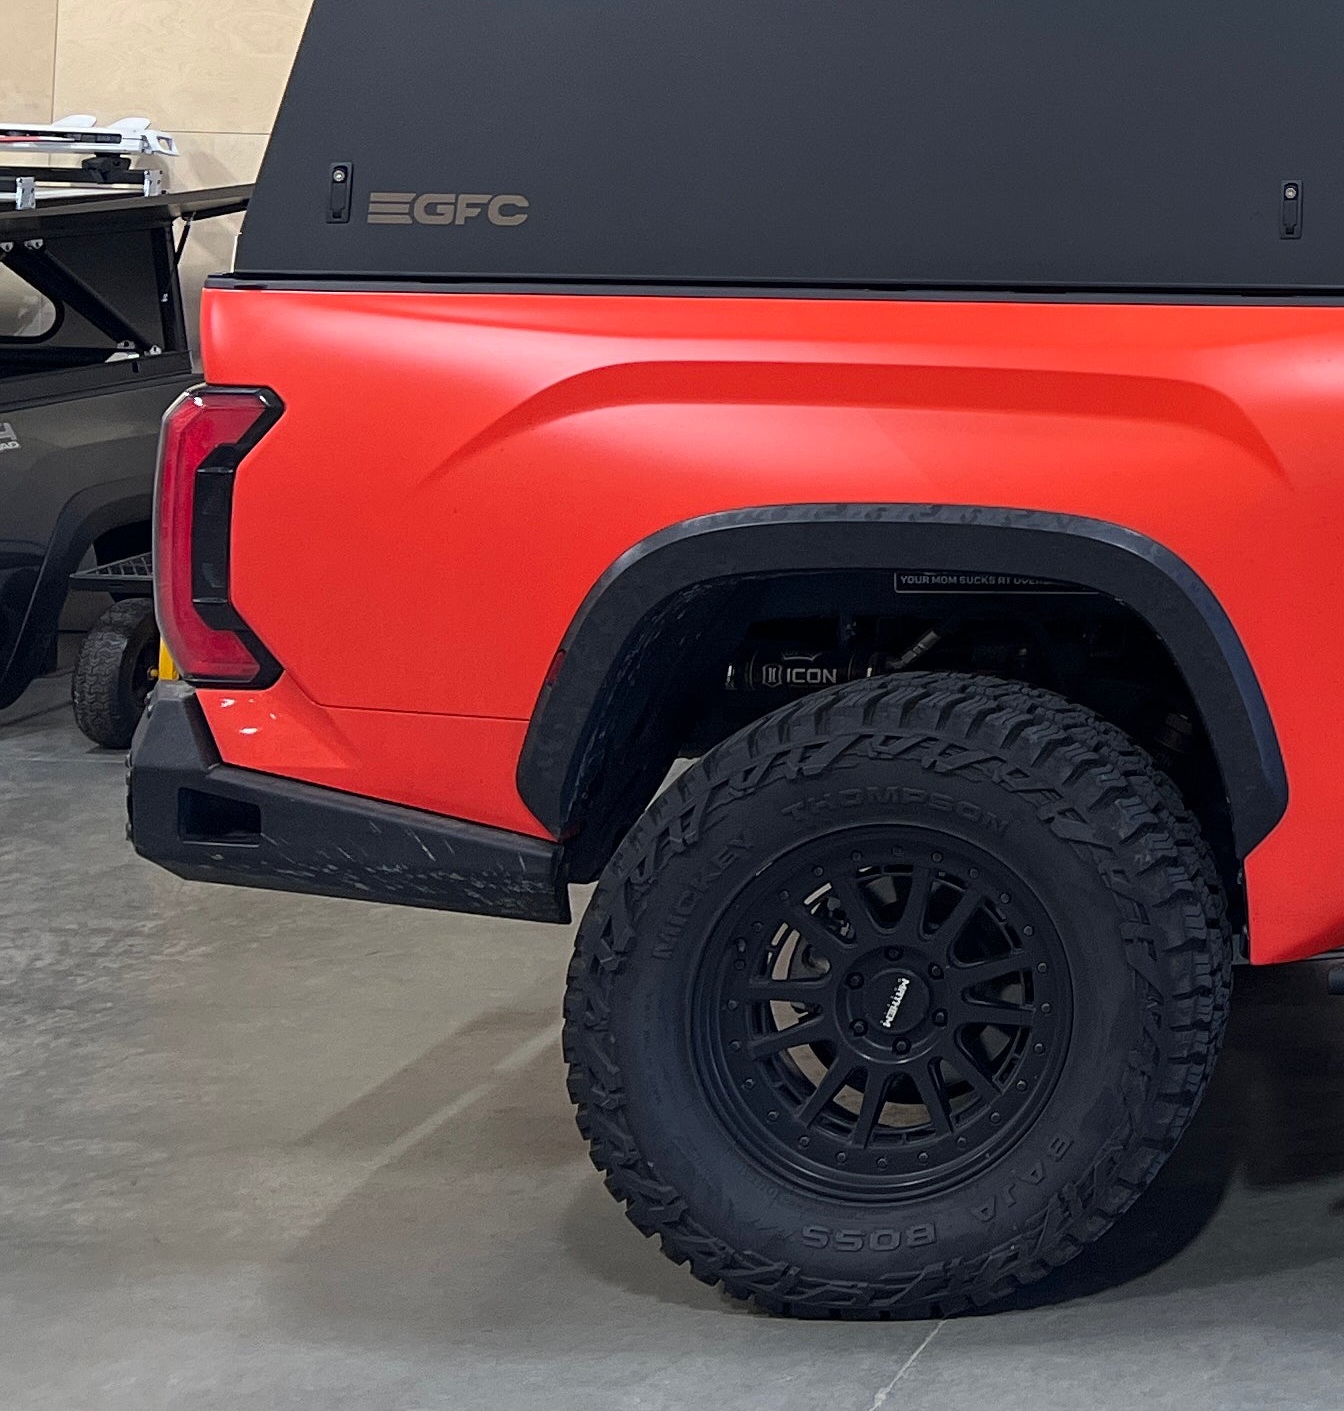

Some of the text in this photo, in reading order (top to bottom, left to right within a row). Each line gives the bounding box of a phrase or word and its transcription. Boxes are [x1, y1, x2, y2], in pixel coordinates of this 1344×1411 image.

[901, 575, 930, 585] YOUR
[931, 575, 957, 585] MOM
[959, 575, 996, 585] SUCKS
[786, 667, 838, 684] ICON
[653, 785, 1009, 960] MICKEY THOMPSON
[800, 1133, 1074, 1253] BAJA BOSS
